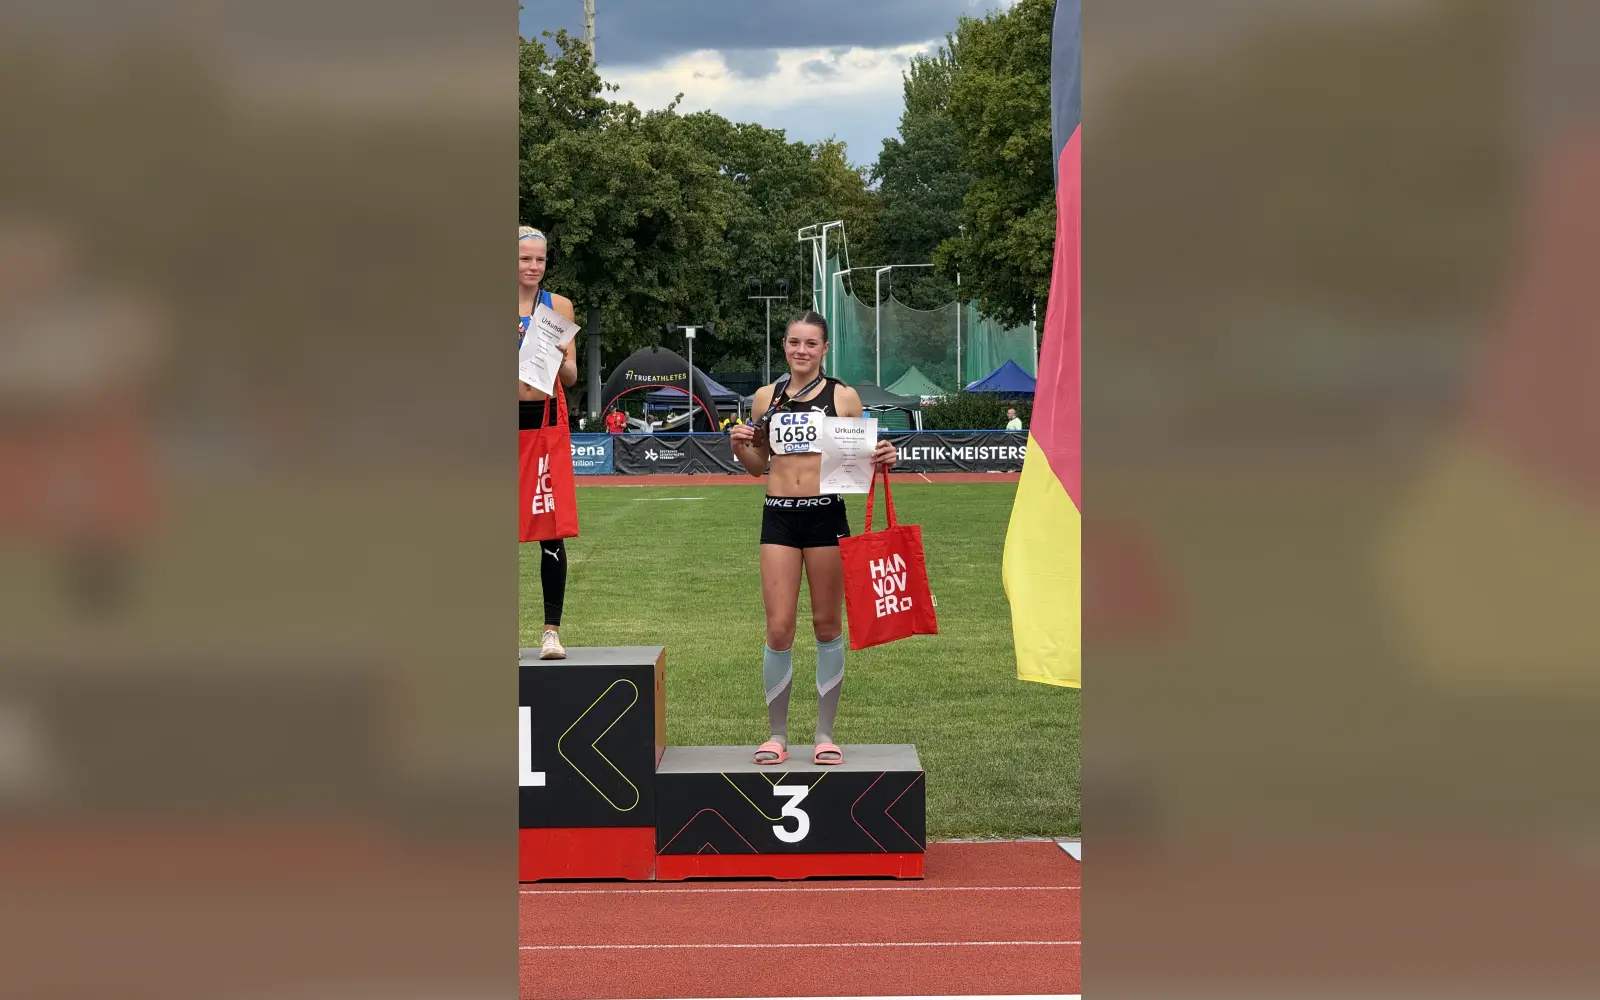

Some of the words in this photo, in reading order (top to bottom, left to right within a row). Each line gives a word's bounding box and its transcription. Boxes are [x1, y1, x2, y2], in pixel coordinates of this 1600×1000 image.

[541, 316, 565, 335] Urkunde
[633, 372, 687, 382] TRUEATHLETES
[775, 425, 817, 443] 1658
[834, 427, 865, 435] Urkunde
[765, 497, 795, 508] NIKE
[795, 497, 832, 508] PRO
[869, 553, 907, 579] HAN
[875, 594, 900, 618] ER
[772, 785, 811, 843] 3
